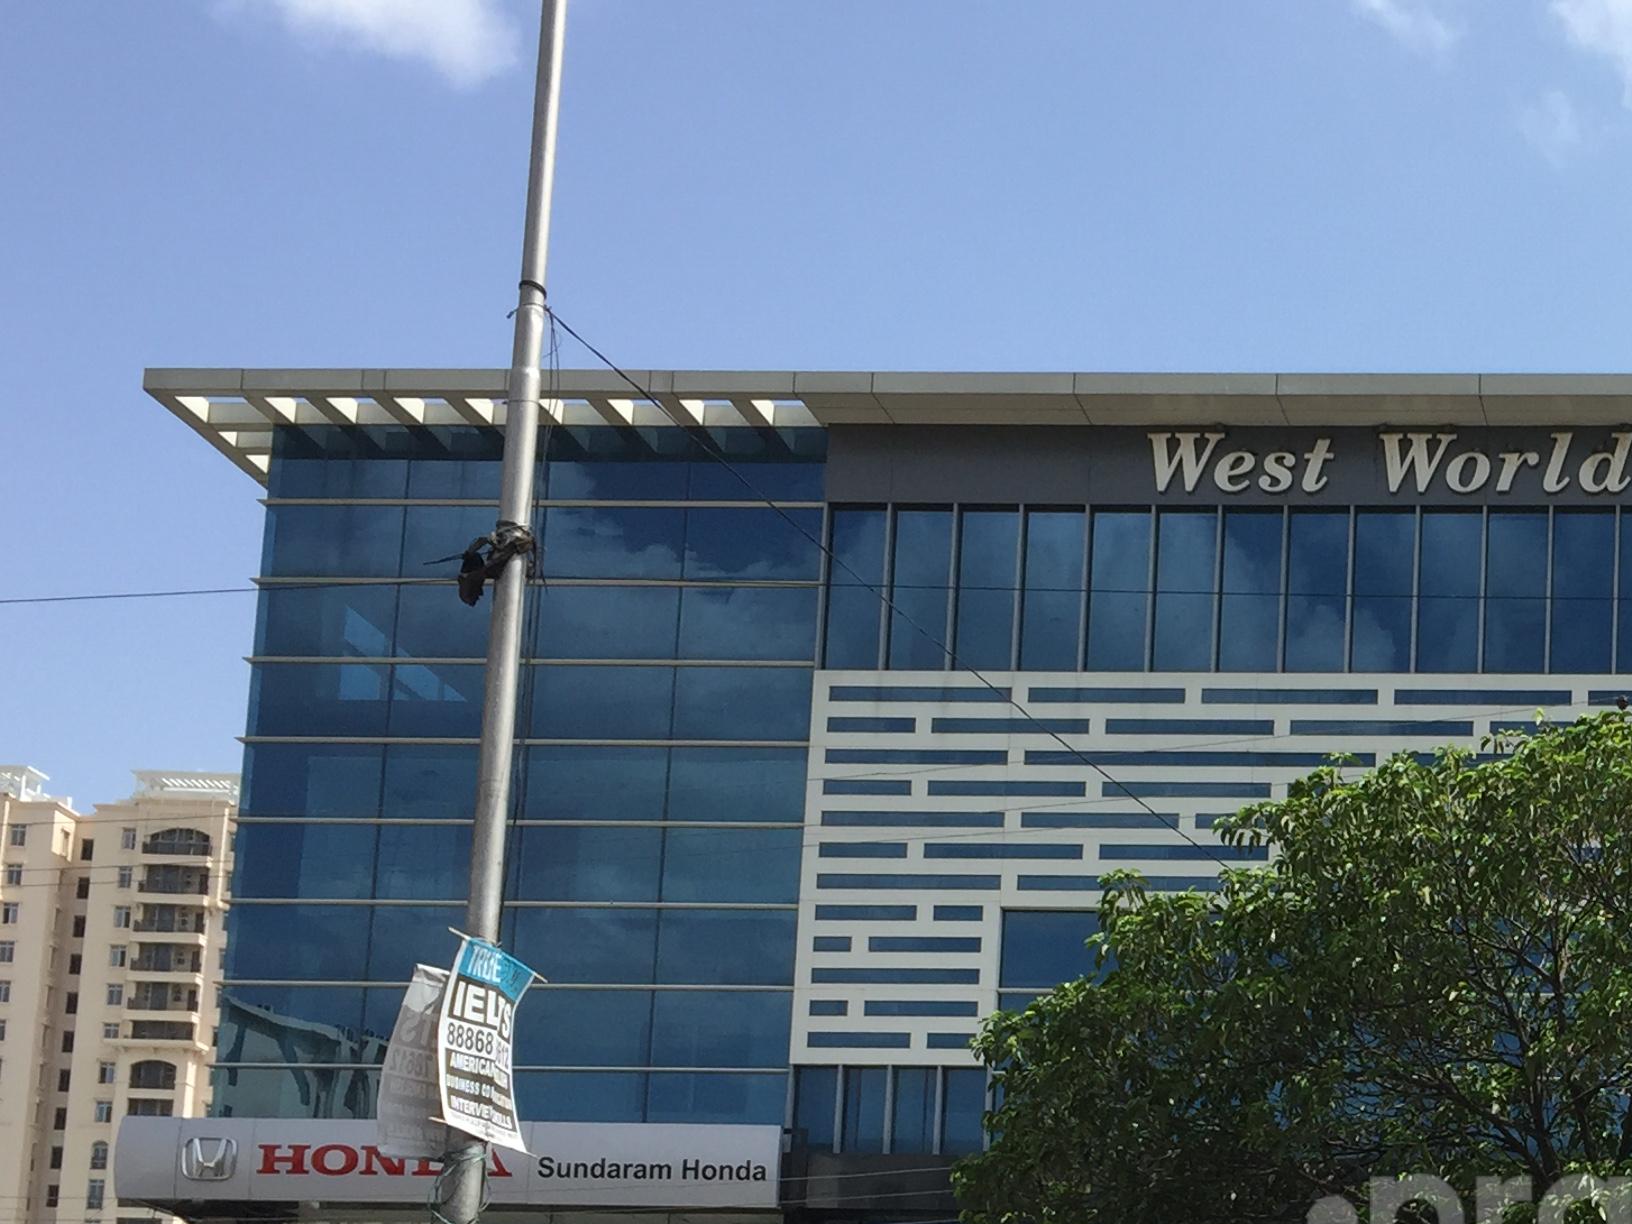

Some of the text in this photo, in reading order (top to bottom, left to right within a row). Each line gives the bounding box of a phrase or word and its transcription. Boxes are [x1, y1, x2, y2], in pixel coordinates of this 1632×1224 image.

[1147, 432, 1334, 493] West
[466, 945, 502, 983] TRUE
[446, 1021, 494, 1055] 88868
[537, 1156, 767, 1181] Sundaram Honda
